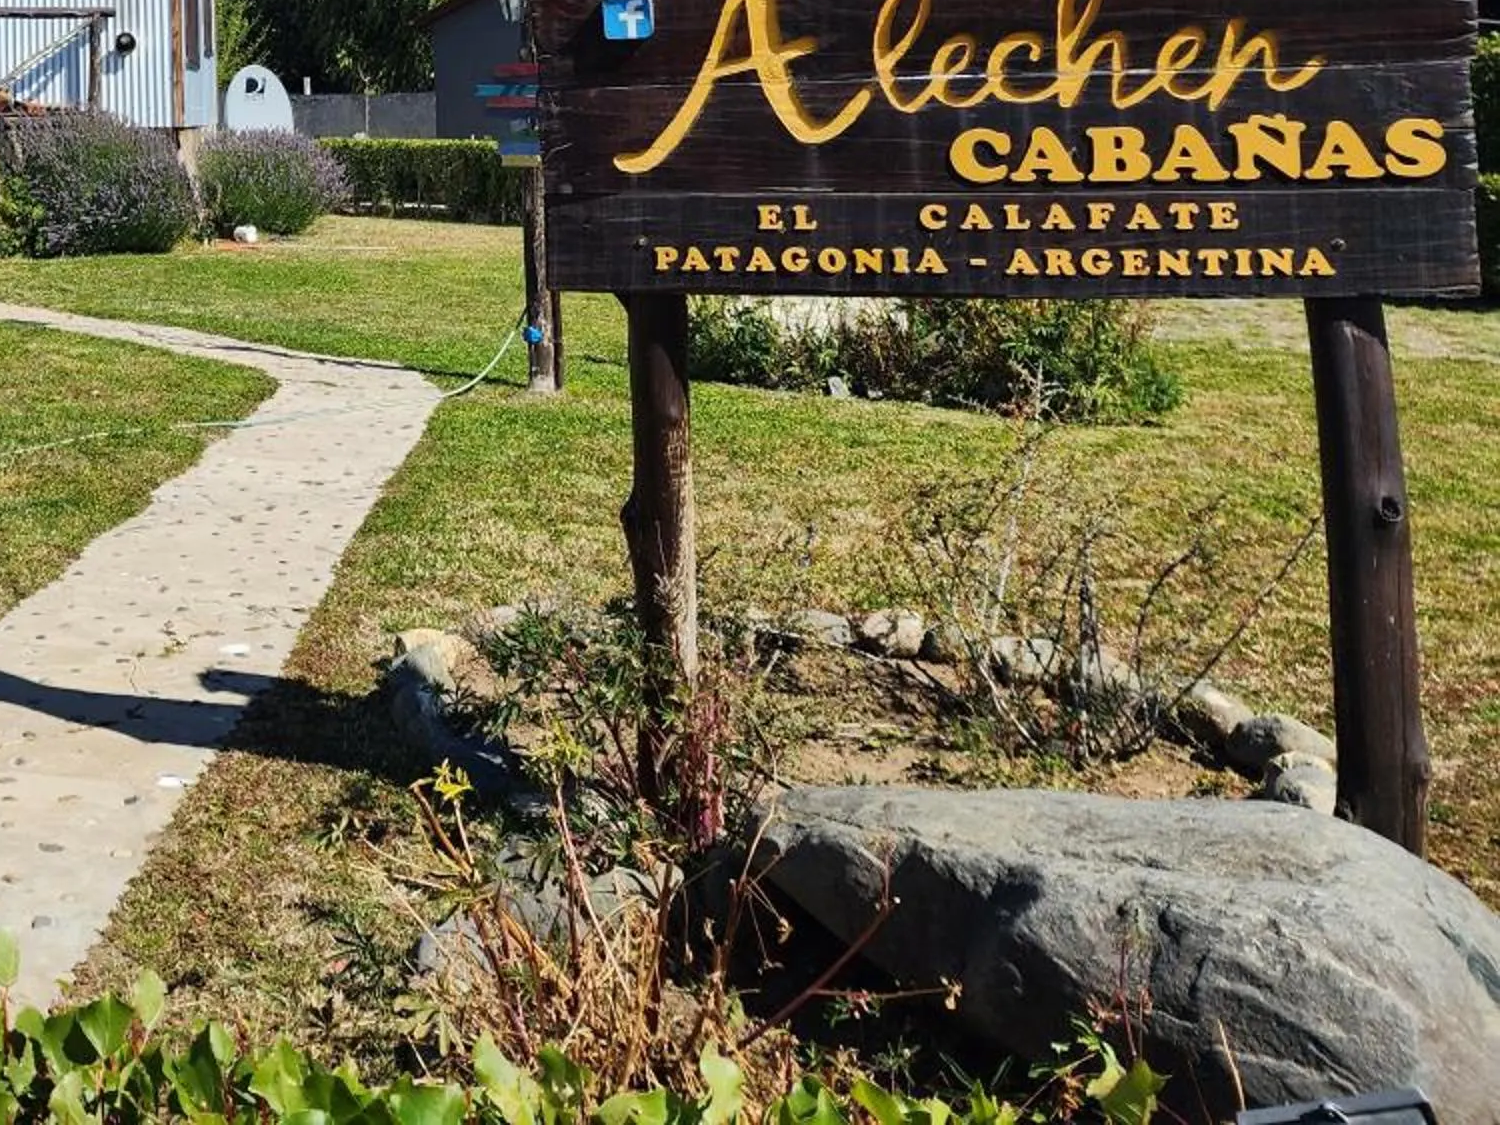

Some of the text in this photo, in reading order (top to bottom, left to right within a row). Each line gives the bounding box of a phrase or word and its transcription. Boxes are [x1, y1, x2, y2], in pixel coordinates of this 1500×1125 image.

[949, 114, 1447, 183] CABAÑAS
[757, 202, 1240, 231] EL CALAFATE
[655, 246, 947, 274] PATAGONIA
[1006, 249, 1336, 276] ARGENTINA
